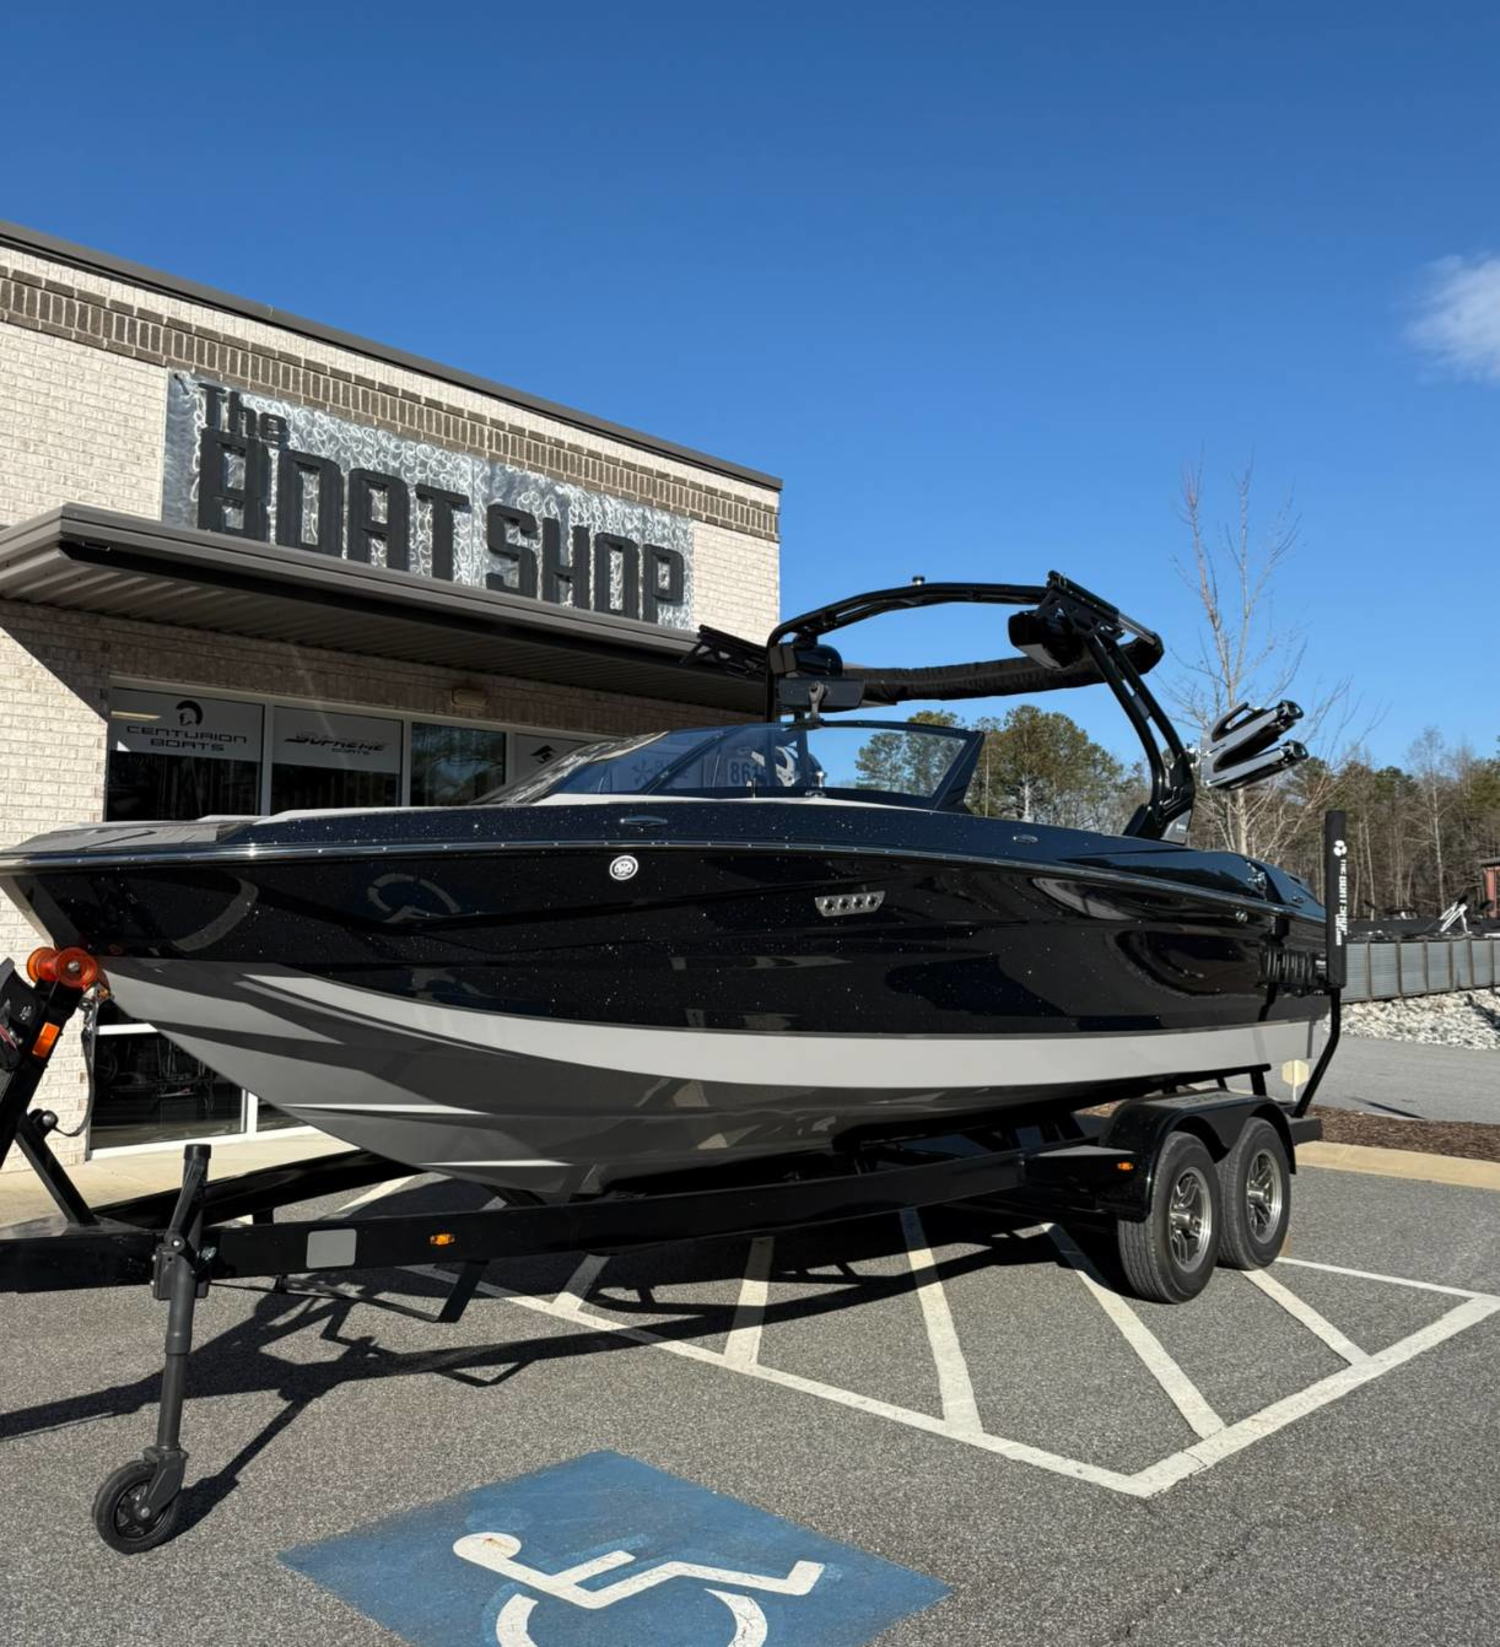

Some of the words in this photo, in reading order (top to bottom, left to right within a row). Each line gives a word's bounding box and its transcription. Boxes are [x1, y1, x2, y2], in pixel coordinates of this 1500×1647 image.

[198, 382, 288, 446] The
[197, 427, 472, 582] BOAT
[486, 503, 685, 624] SHOP
[126, 725, 248, 744] CENTURION
[150, 738, 225, 752] BOATS
